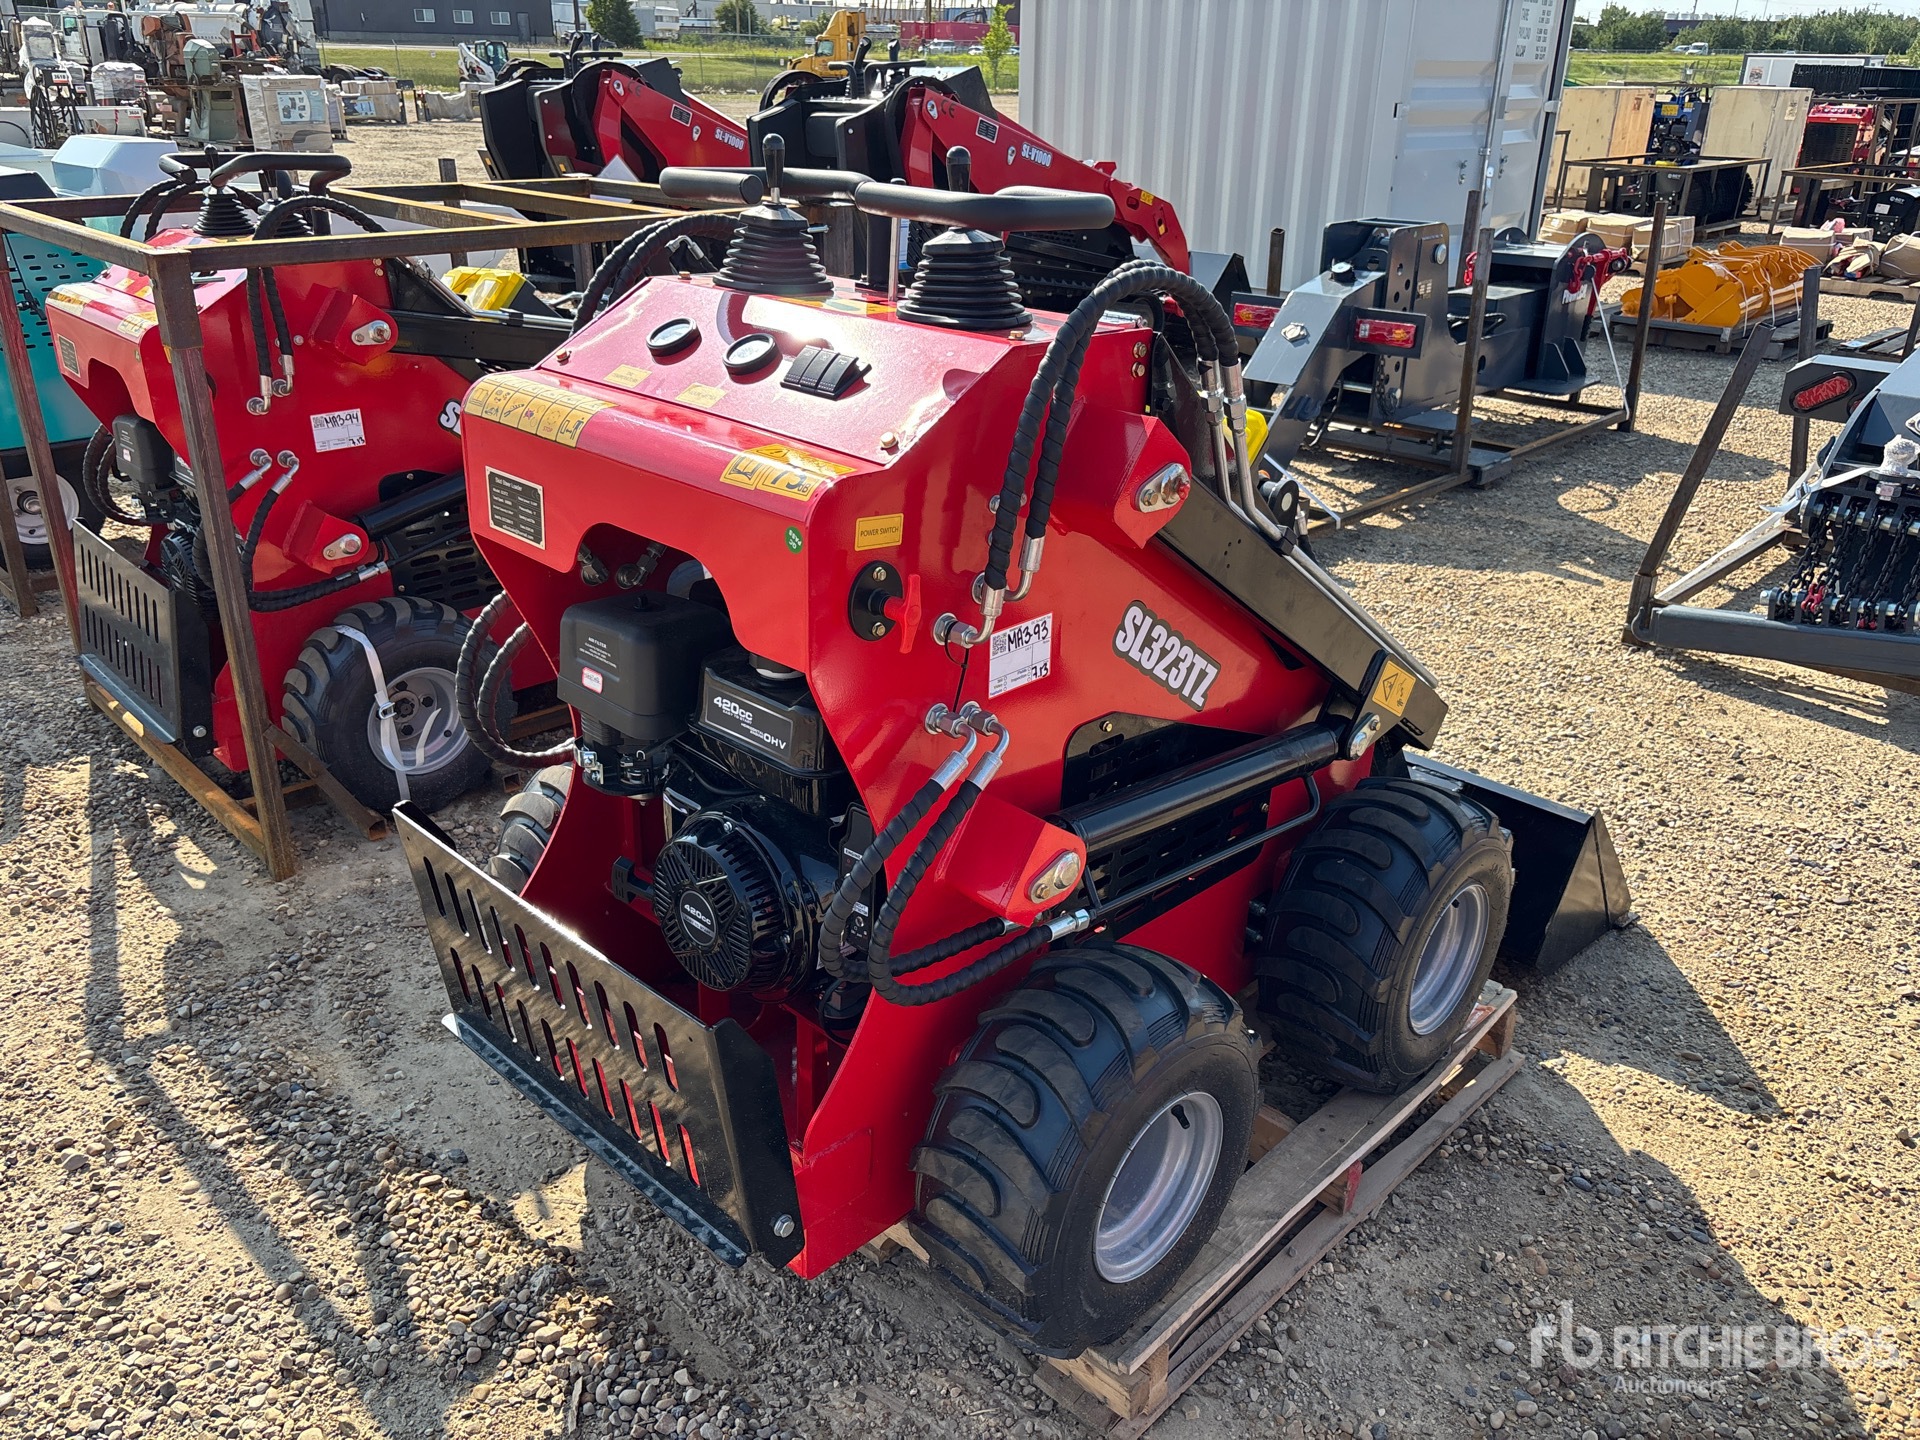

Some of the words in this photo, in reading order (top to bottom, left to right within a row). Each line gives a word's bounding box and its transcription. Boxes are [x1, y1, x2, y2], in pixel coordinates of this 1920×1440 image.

[715, 127, 744, 151] SL-V1000
[1021, 142, 1052, 167] SL-V1000
[788, 529, 802, 546] PASS
[860, 528, 879, 537] POWER
[879, 526, 899, 535] SWITCH
[1115, 606, 1218, 707] SL323TZ
[713, 696, 753, 721] 420cc
[763, 732, 787, 750] OHV
[684, 904, 711, 925] 420cc
